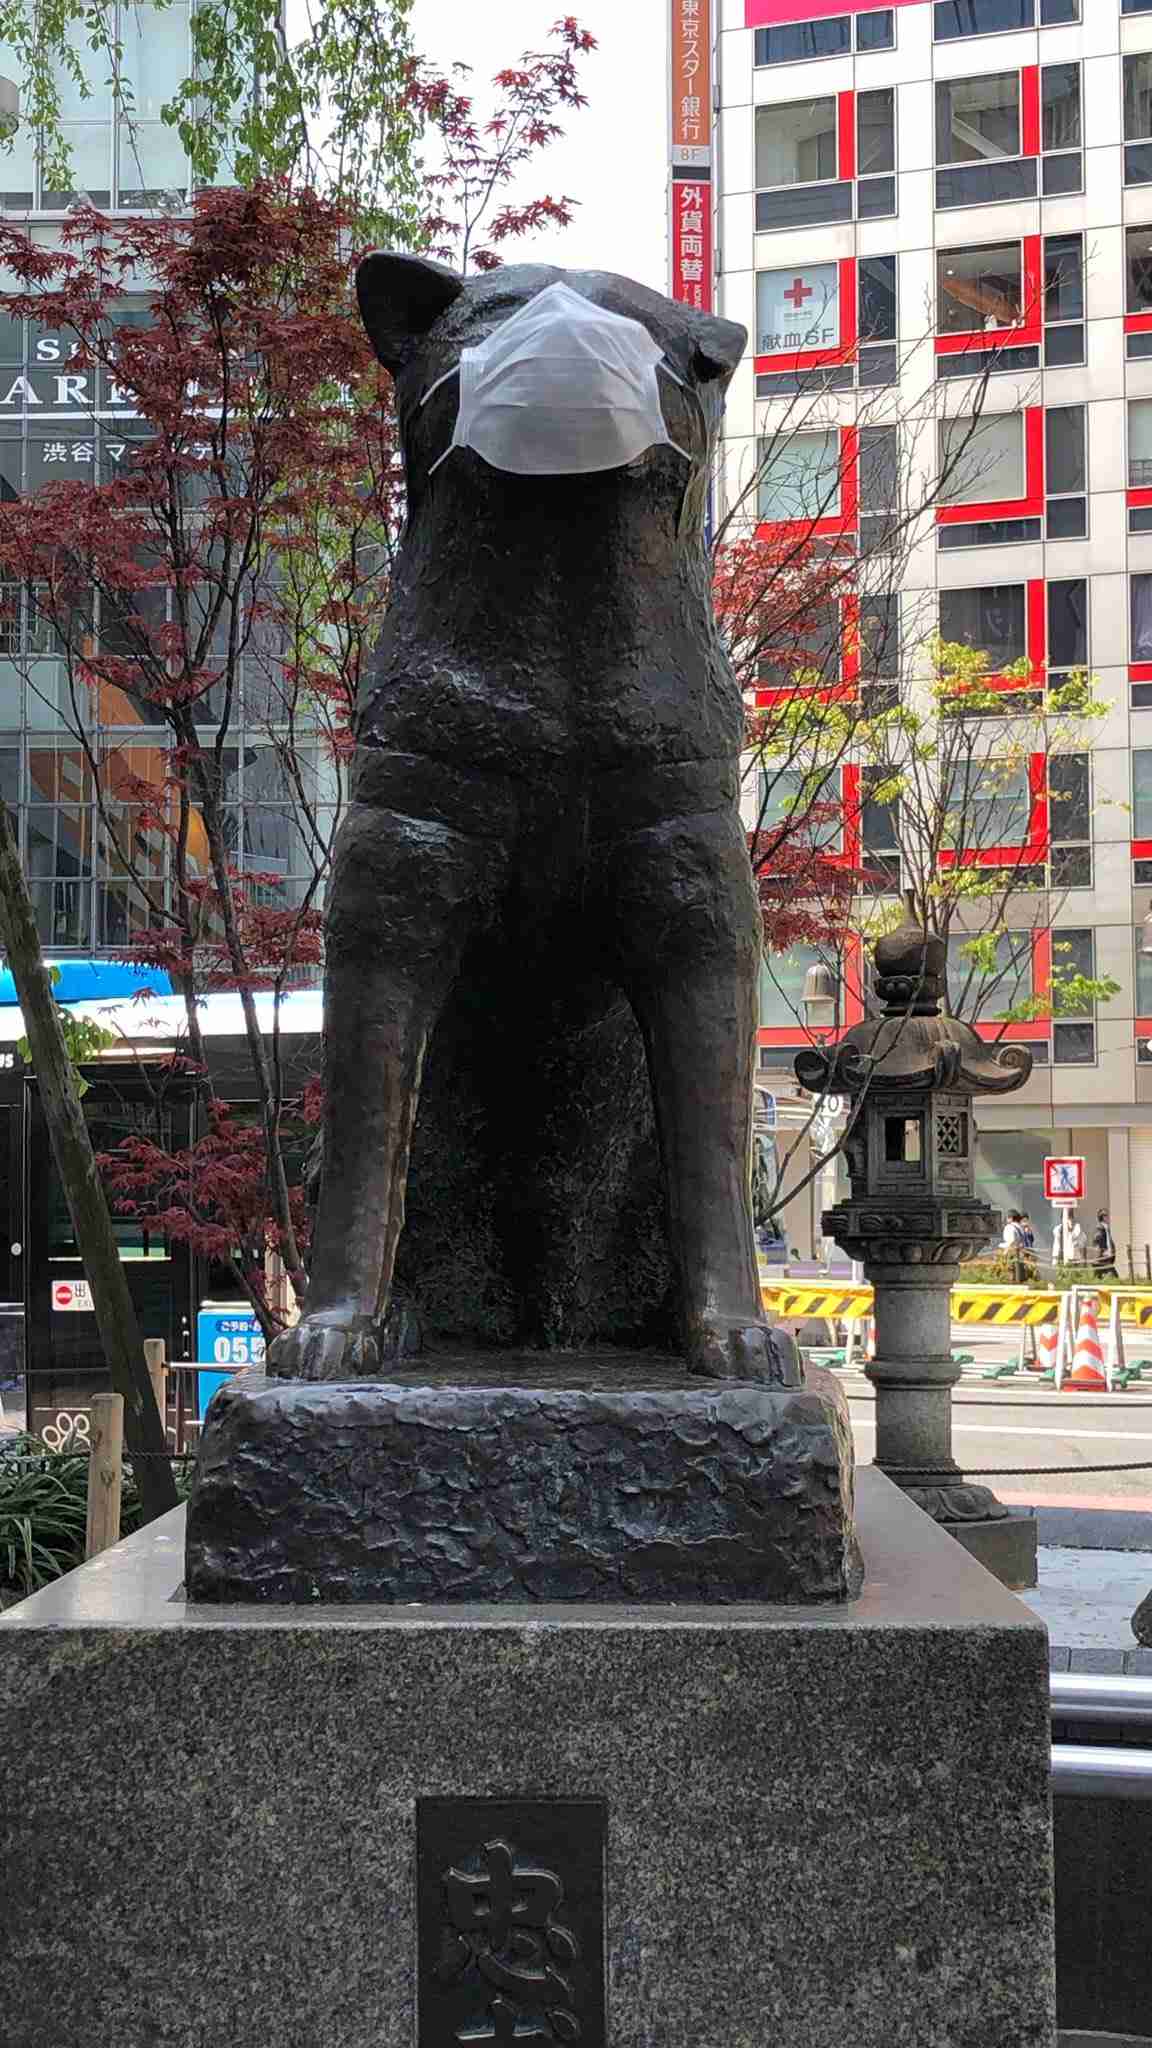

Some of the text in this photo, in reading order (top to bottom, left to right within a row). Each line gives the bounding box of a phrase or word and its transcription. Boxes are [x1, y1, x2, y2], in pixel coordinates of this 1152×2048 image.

[681, 147, 703, 160] 8F
[680, 186, 703, 281] 外貨両替
